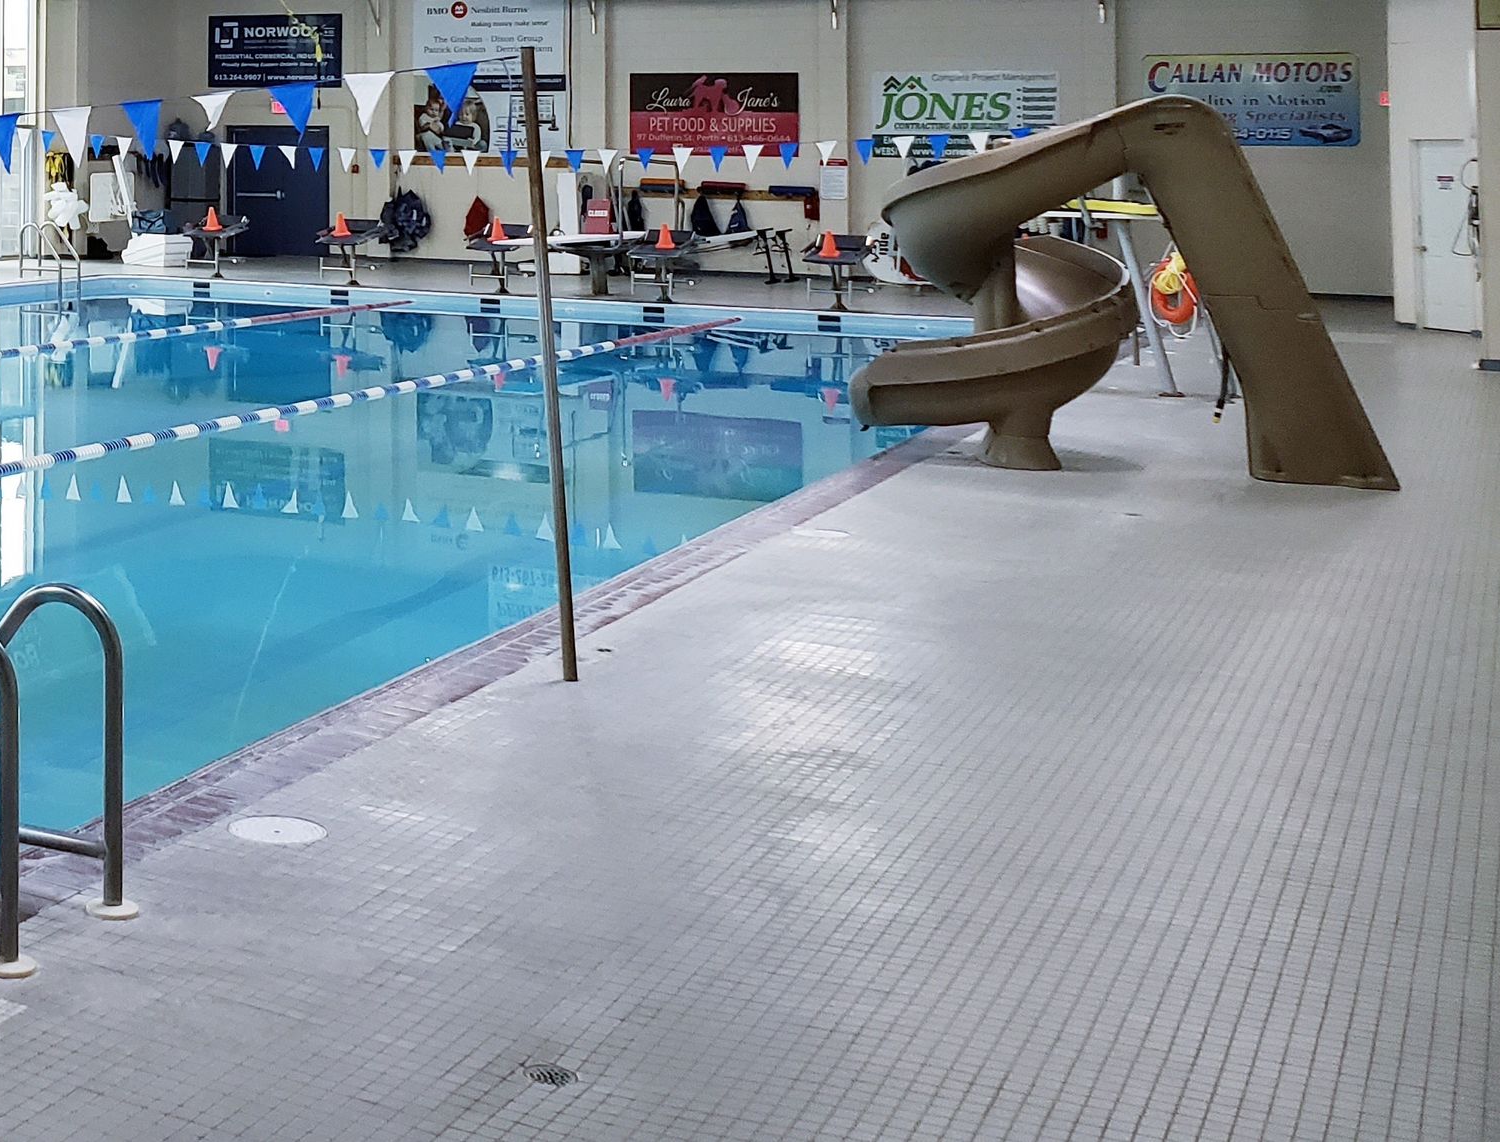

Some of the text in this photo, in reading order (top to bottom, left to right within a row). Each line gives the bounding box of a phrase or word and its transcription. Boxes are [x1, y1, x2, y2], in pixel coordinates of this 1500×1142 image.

[427, 7, 448, 15] BMO
[471, 6, 500, 14] Nesbitt
[244, 26, 320, 38] NORWOO
[450, 35, 482, 43] Graham
[517, 35, 543, 44] Group
[267, 73, 335, 81] www.norwoodo.ca
[1148, 61, 1352, 93] CALLAN MOTORS
[645, 86, 779, 117] Laura Jane's
[875, 92, 1012, 130] JONES
[650, 117, 777, 132] PET FOOD & SUPPLIES
